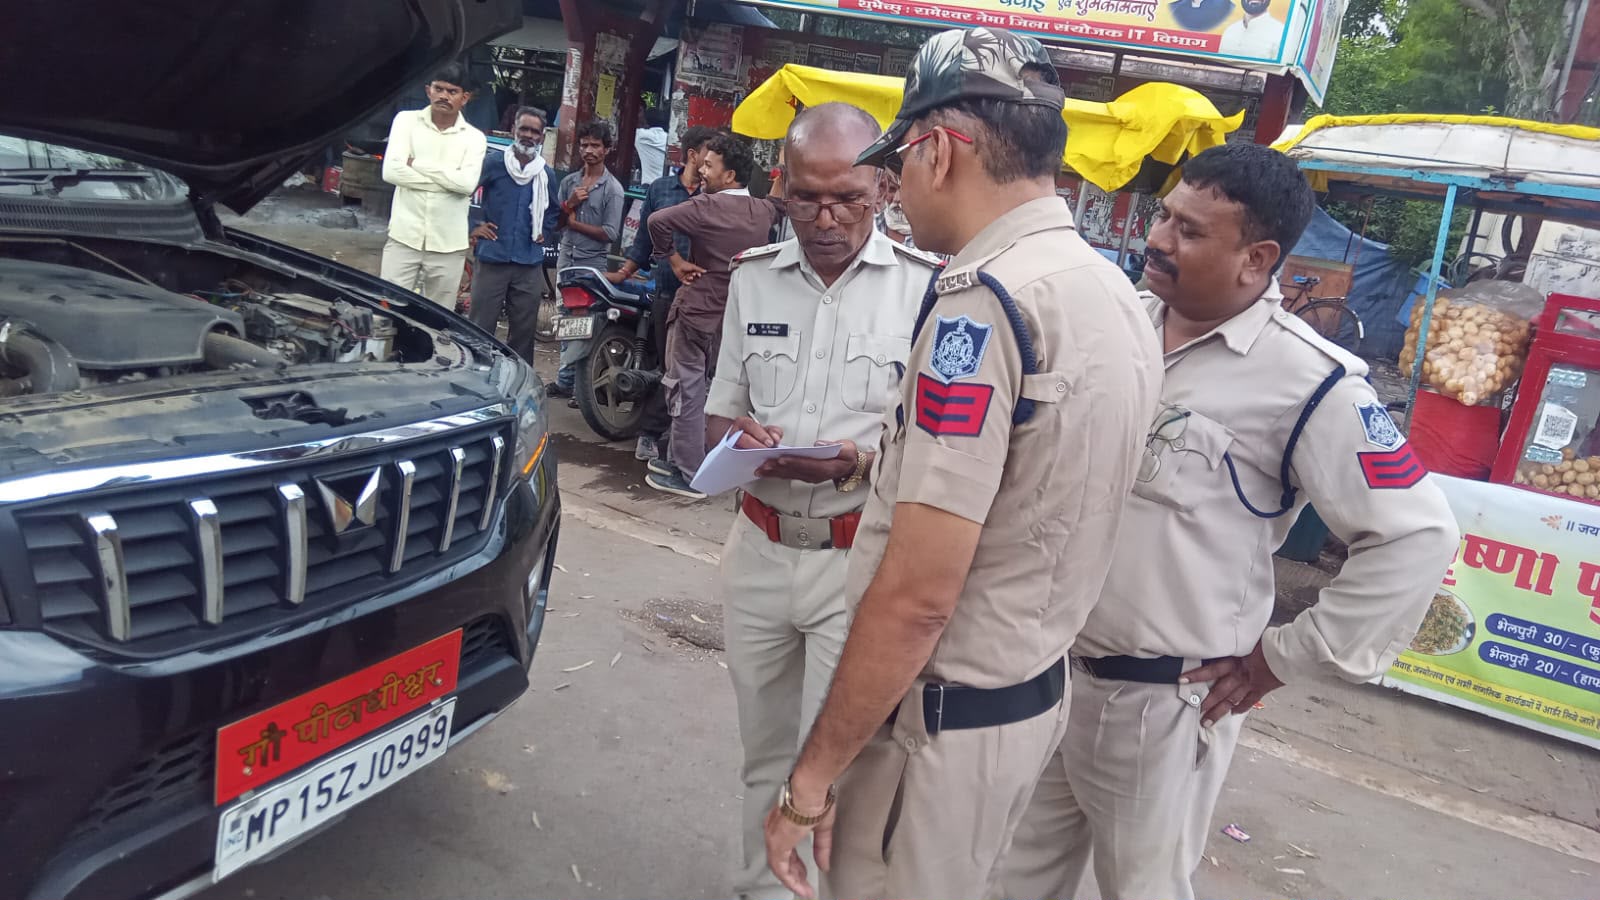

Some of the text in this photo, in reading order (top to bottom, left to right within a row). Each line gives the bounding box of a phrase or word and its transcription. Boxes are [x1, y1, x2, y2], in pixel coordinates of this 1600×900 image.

[914, 5, 973, 21] रामेश्वर
[1009, 14, 1049, 30] जिला
[1054, 20, 1123, 38] संयोजक
[1128, 28, 1145, 40] IT
[1152, 29, 1208, 47] विभाग
[1497, 618, 1537, 641] भेलपुरी
[1543, 632, 1577, 650] 30/-
[1489, 645, 1529, 668] भेलपुरी
[1535, 660, 1569, 677] 20/-
